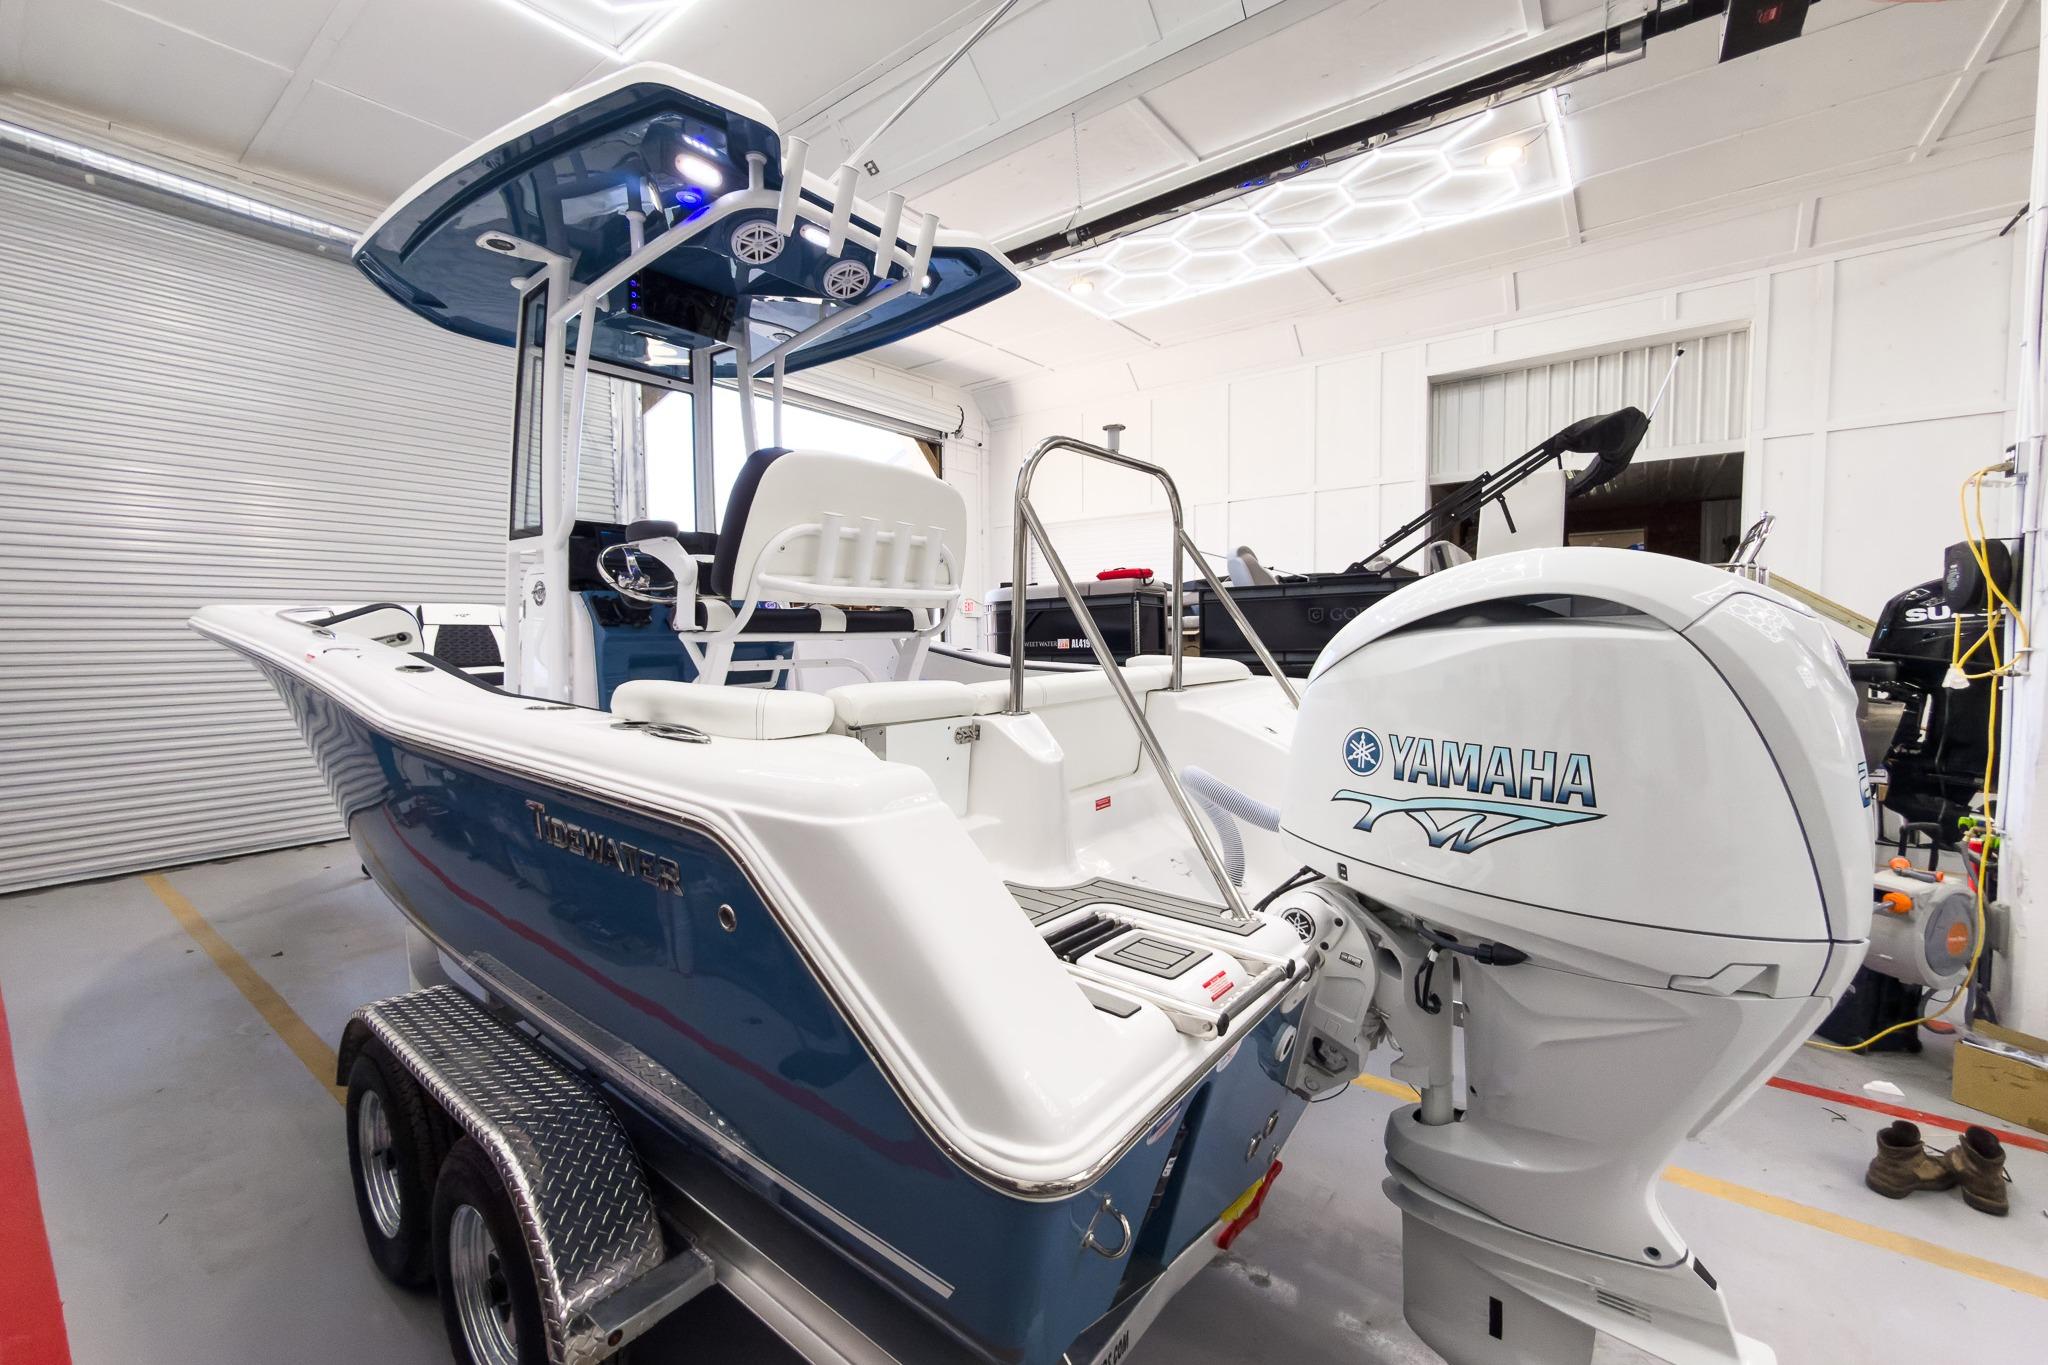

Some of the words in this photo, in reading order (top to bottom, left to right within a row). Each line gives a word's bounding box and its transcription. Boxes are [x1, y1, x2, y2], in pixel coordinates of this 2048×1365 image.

[1071, 639, 1093, 649] AL419
[1388, 734, 1597, 808] YAMAHA
[525, 799, 684, 897] TIDEWATER
